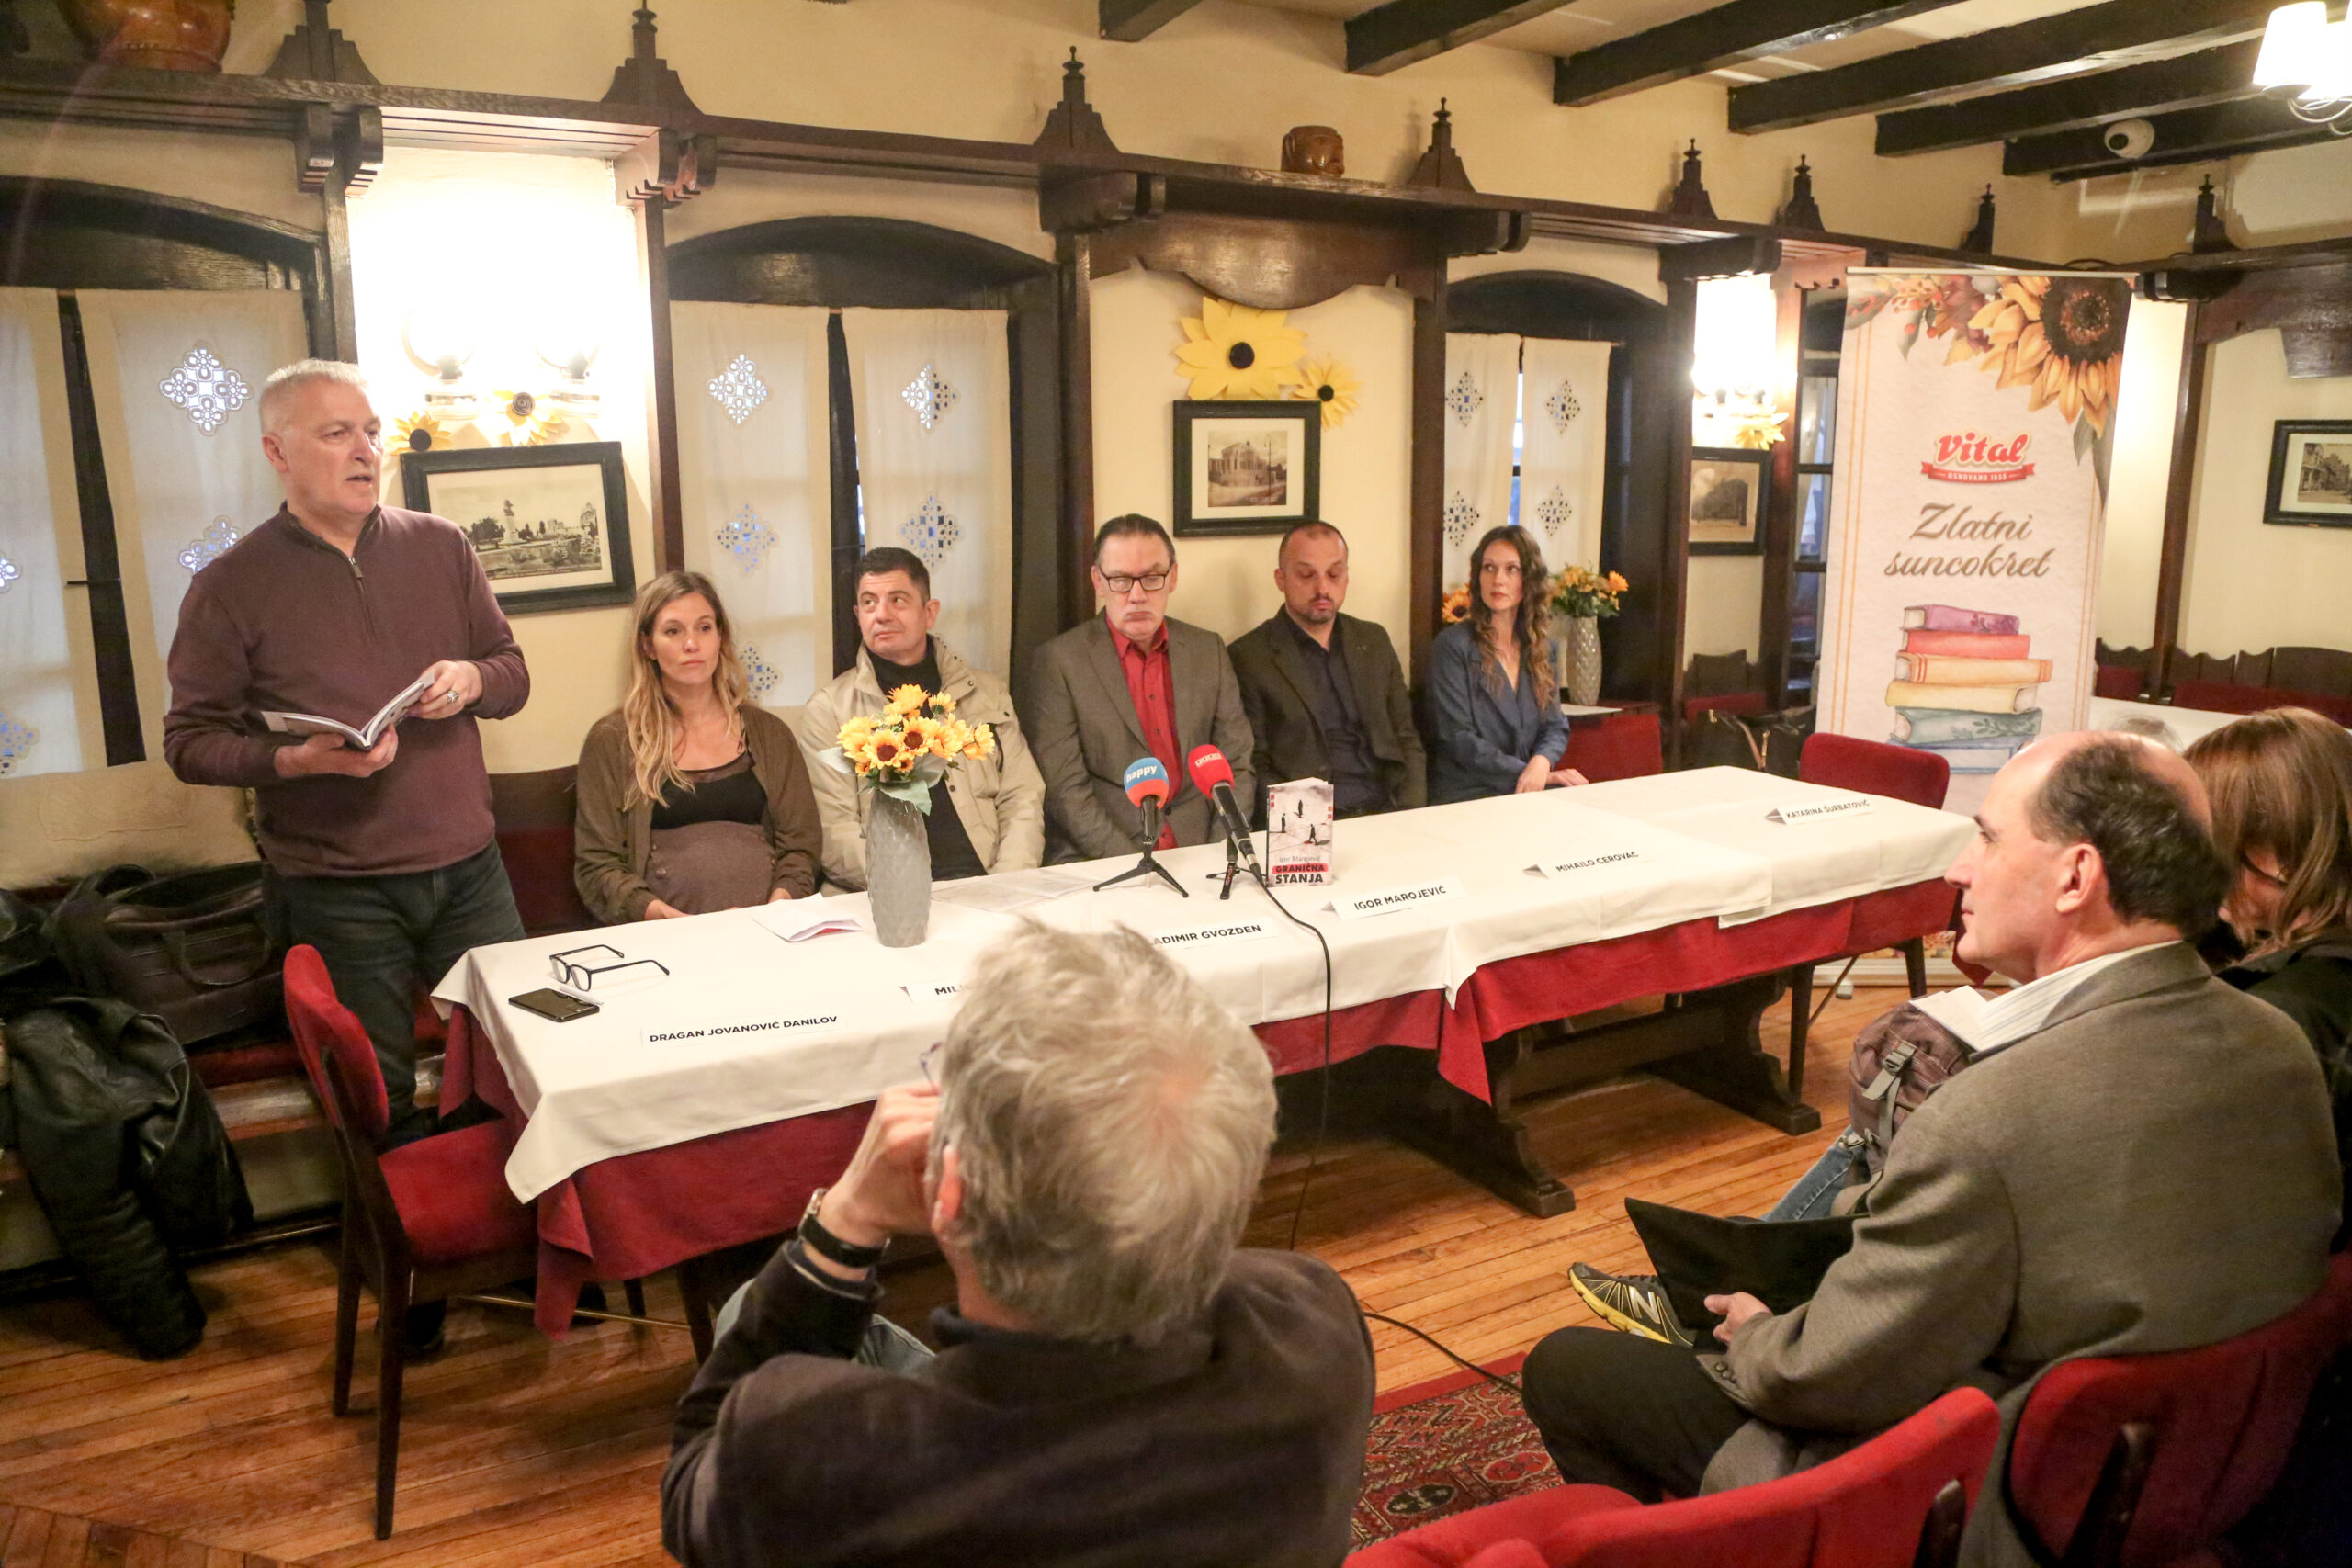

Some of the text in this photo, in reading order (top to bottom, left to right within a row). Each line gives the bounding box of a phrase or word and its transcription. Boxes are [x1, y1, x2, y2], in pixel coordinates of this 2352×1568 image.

[1937, 432, 2029, 463] Vital
[1909, 502, 2033, 540] Zlatni
[1883, 543, 2056, 578] suncokret
[1126, 765, 1158, 784] happy
[1786, 807, 1824, 818] KATARINA
[1555, 851, 1638, 872] MIHAILO CEROVAC
[1275, 873, 1323, 885] STANJA
[1353, 885, 1447, 910] IGOR MAROJEVIĆ
[1150, 924, 1261, 946] ADIMIR GVOZDEN
[650, 1015, 838, 1043] DRAGAN JOVANOVIĆ DANILOV
